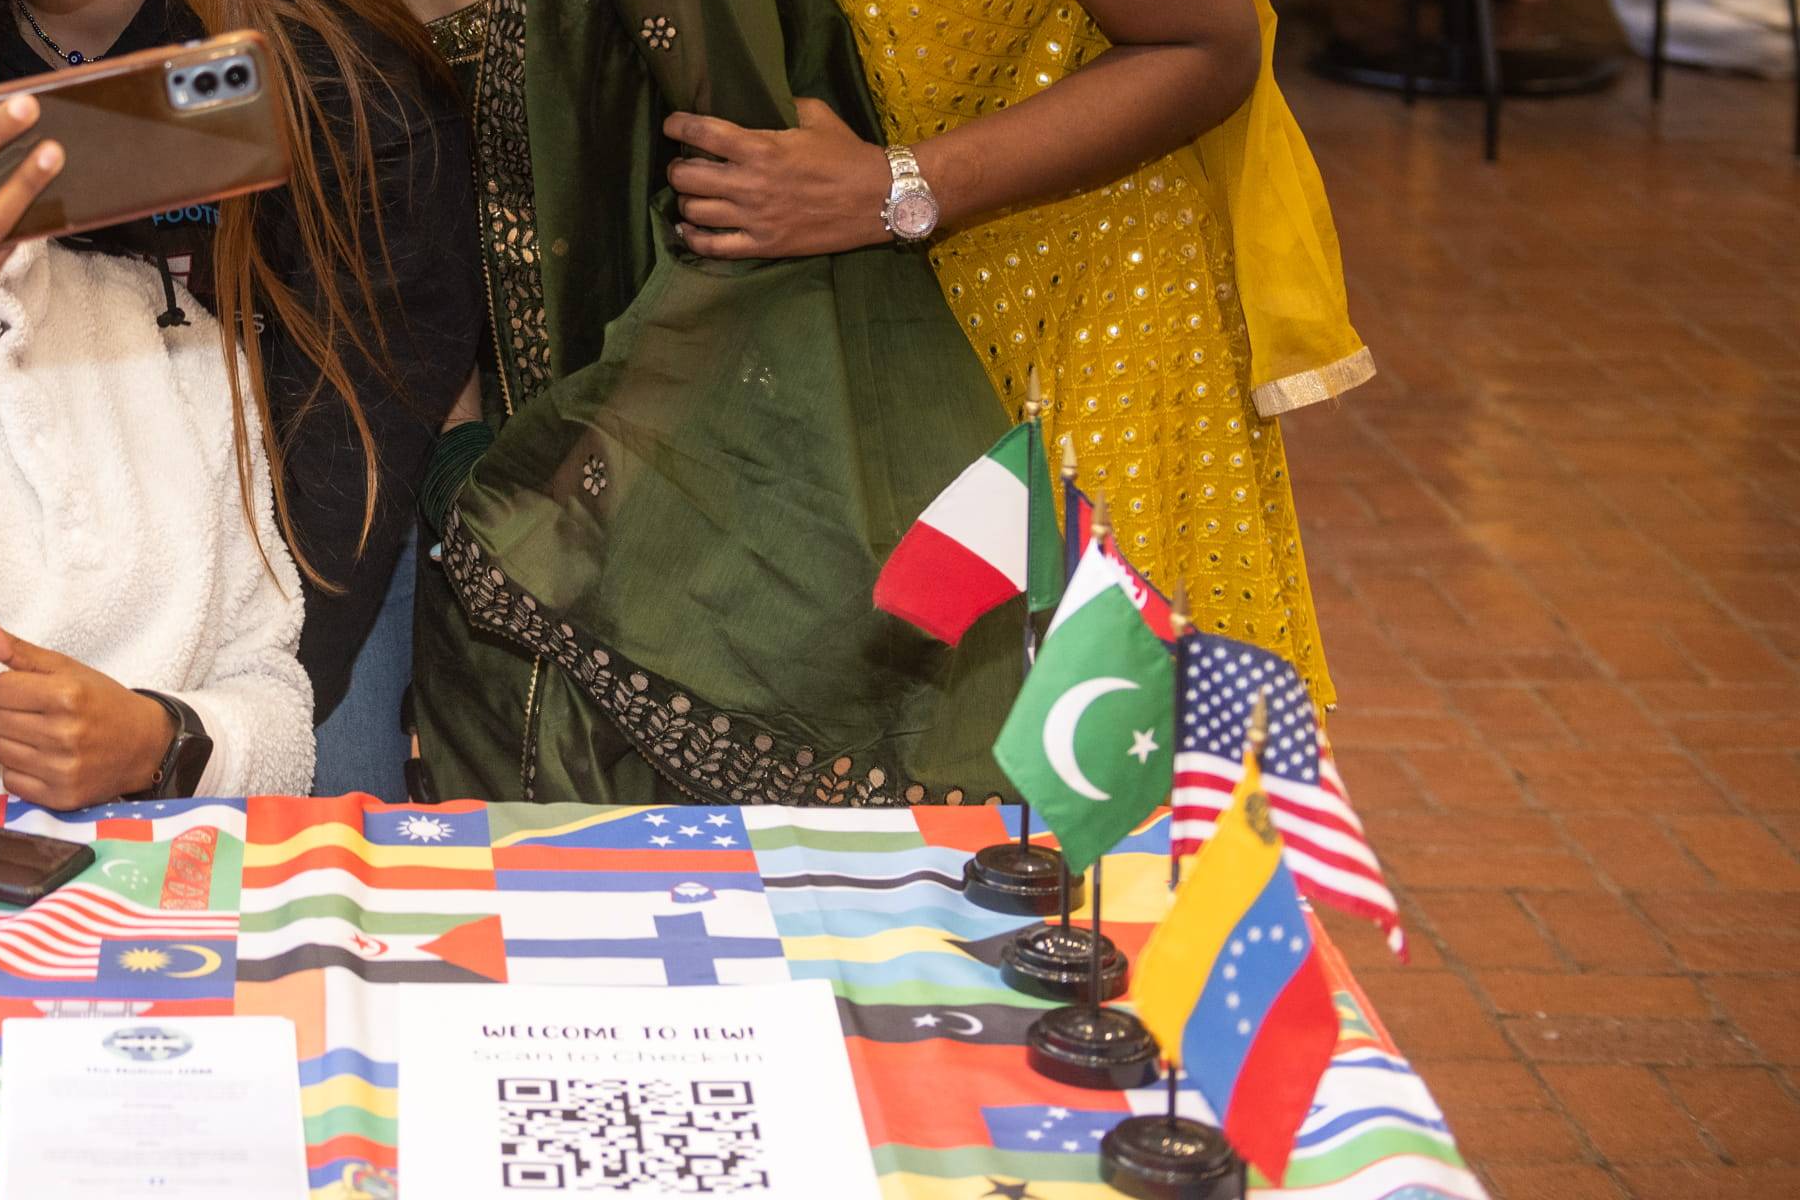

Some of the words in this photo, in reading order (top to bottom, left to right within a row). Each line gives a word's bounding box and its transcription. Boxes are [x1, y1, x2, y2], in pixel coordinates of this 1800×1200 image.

[481, 1024, 624, 1040] WELCOME
[641, 1026, 678, 1040] TO
[472, 1046, 554, 1063] Scan
[563, 1047, 602, 1063] to
